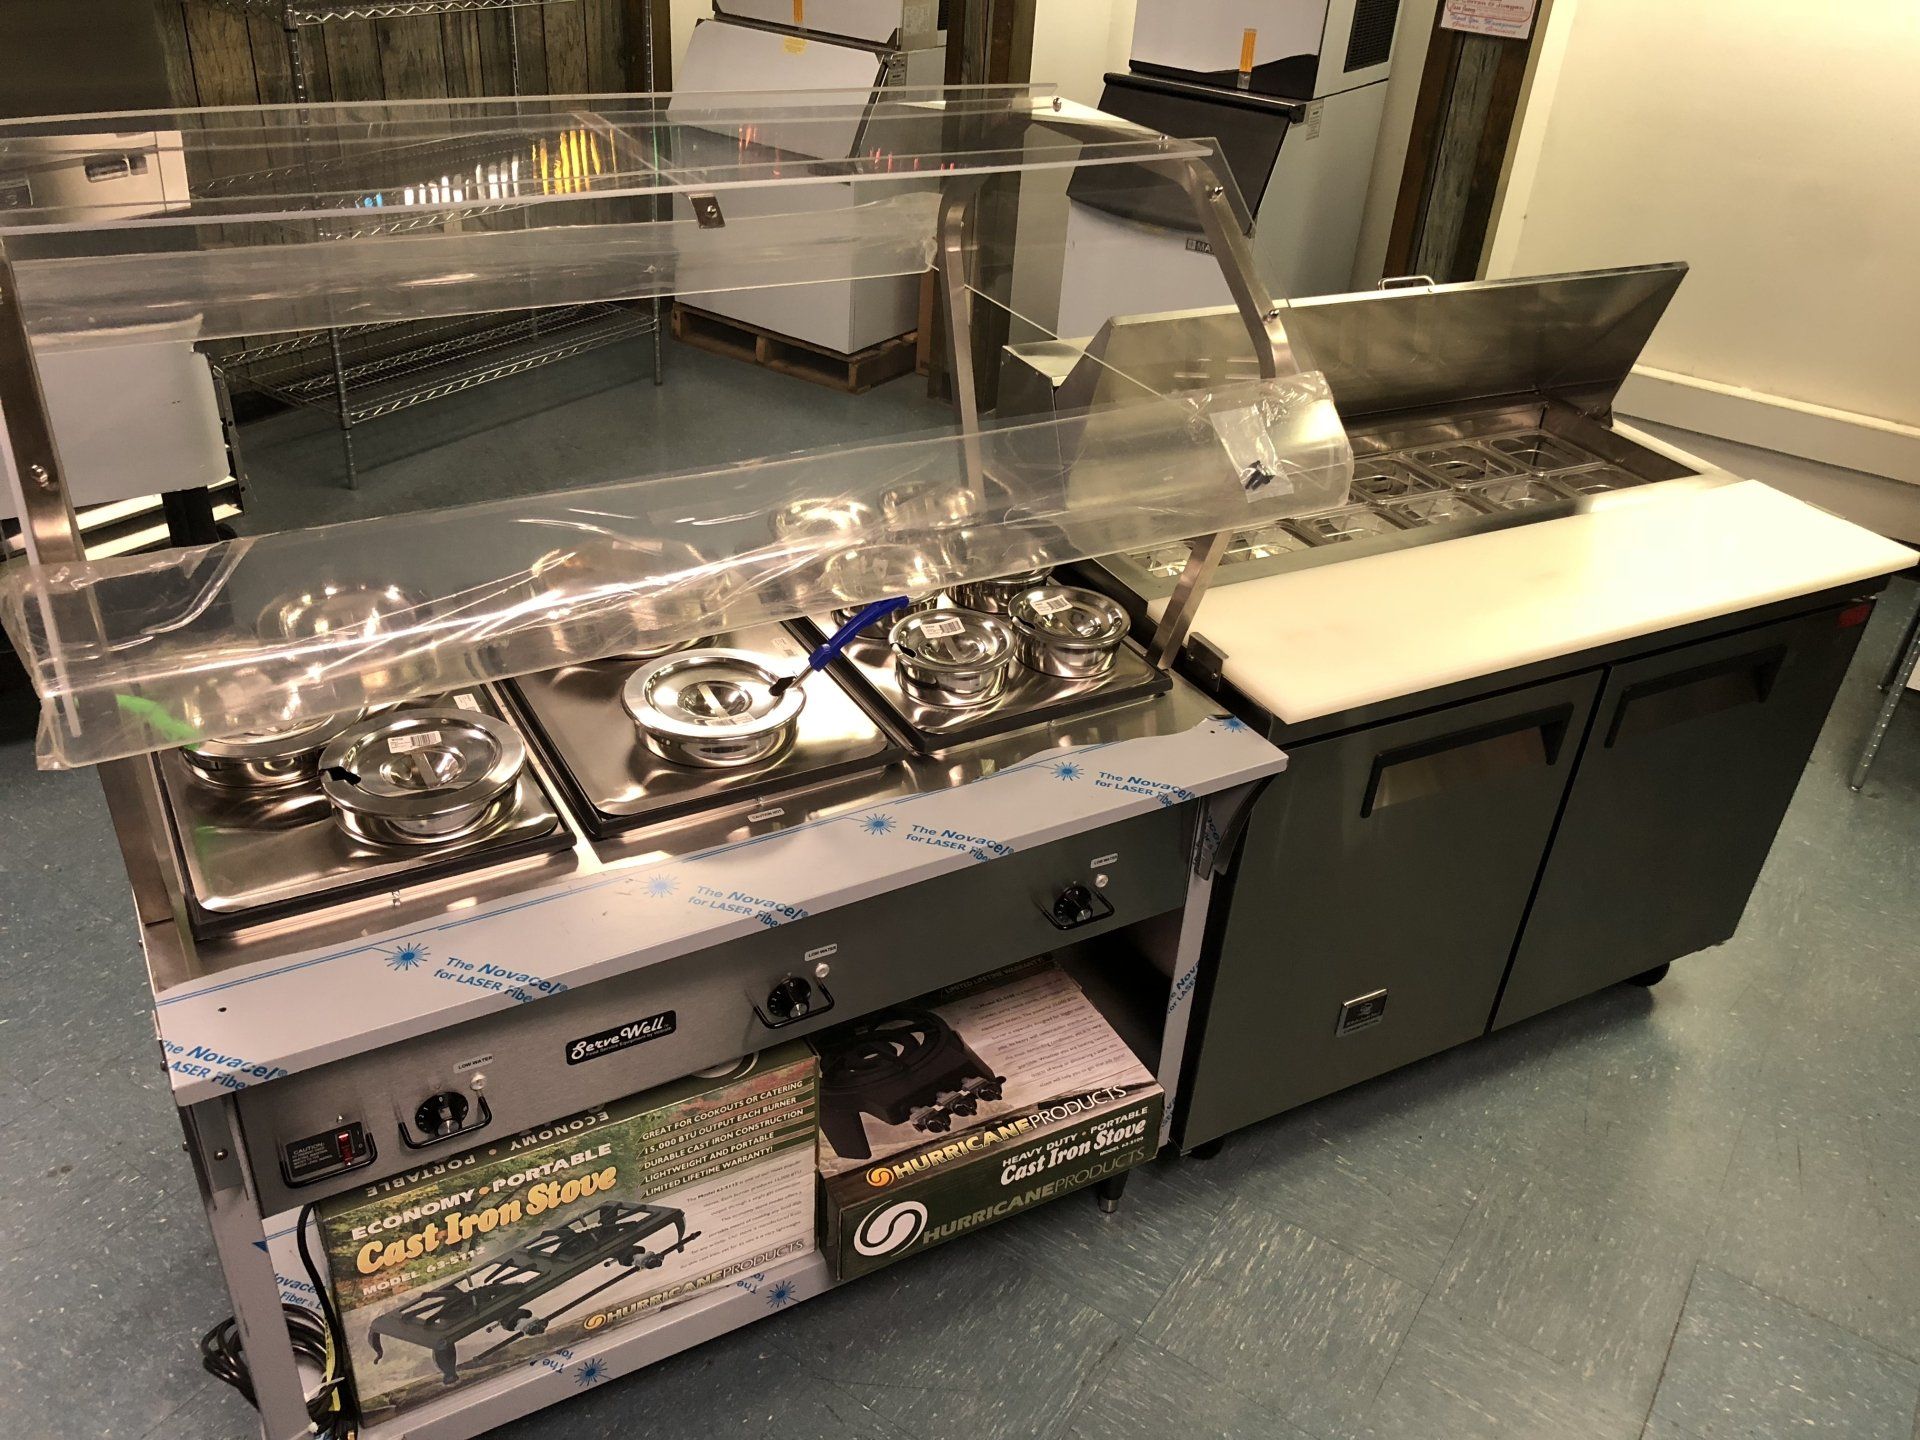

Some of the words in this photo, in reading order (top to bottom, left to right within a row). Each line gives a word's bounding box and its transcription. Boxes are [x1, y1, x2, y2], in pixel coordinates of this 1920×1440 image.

[1094, 780, 1112, 788] for
[1116, 783, 1153, 796] LASER
[1098, 772, 1123, 782] The
[906, 834, 925, 843] for
[926, 837, 966, 851] LASER
[912, 824, 937, 836] The
[688, 896, 710, 906] for
[710, 901, 753, 916] LASER
[697, 886, 724, 898] The
[434, 968, 458, 979] for
[456, 974, 504, 992] LASER
[446, 957, 475, 971] The
[472, 1056, 493, 1065] WATER
[642, 1126, 673, 1140] GREAT
[674, 1118, 693, 1130] FOR
[694, 1101, 744, 1122] COOKOUTS
[746, 1096, 759, 1105] OR
[760, 1081, 804, 1100] CATERING
[644, 1138, 677, 1155] 15,000
[678, 1130, 698, 1142] BTU
[699, 1118, 735, 1135] OUTPUT
[737, 1108, 762, 1122] EACH
[762, 1097, 797, 1114] BURNER
[510, 1110, 610, 1152] ECONOMY
[644, 1148, 686, 1170] DURABLE
[687, 1141, 710, 1154] CAST
[712, 1132, 734, 1145] IRON
[735, 1108, 805, 1136] CONSTRUCTION
[1002, 1146, 1043, 1168] HEAVY
[1046, 1132, 1078, 1151] DUTY
[1090, 1106, 1149, 1134] PORTABLE
[644, 1156, 708, 1184] LIGHTWEIGHT
[708, 1148, 730, 1161] AND
[730, 1132, 775, 1153] PORTABLE
[1000, 1154, 1046, 1186] Cast
[1048, 1141, 1092, 1168] Iron
[1094, 1119, 1147, 1150] Stove
[366, 1154, 477, 1198] PORTABLE
[645, 1178, 681, 1196] LIMITED
[682, 1165, 721, 1184] LIFETIME
[721, 1146, 774, 1170] WARRANTY!
[351, 1188, 476, 1241] ECONOMY
[492, 1142, 612, 1194] PORTABLE
[356, 1222, 440, 1274] Cast
[444, 1199, 522, 1246] Iron
[526, 1166, 618, 1217] Stove
[362, 1271, 420, 1296] MODEL
[426, 1246, 486, 1274] 63-5112
[736, 1280, 757, 1295] The
[280, 1291, 308, 1305] Fiber
[542, 1358, 564, 1374] The
